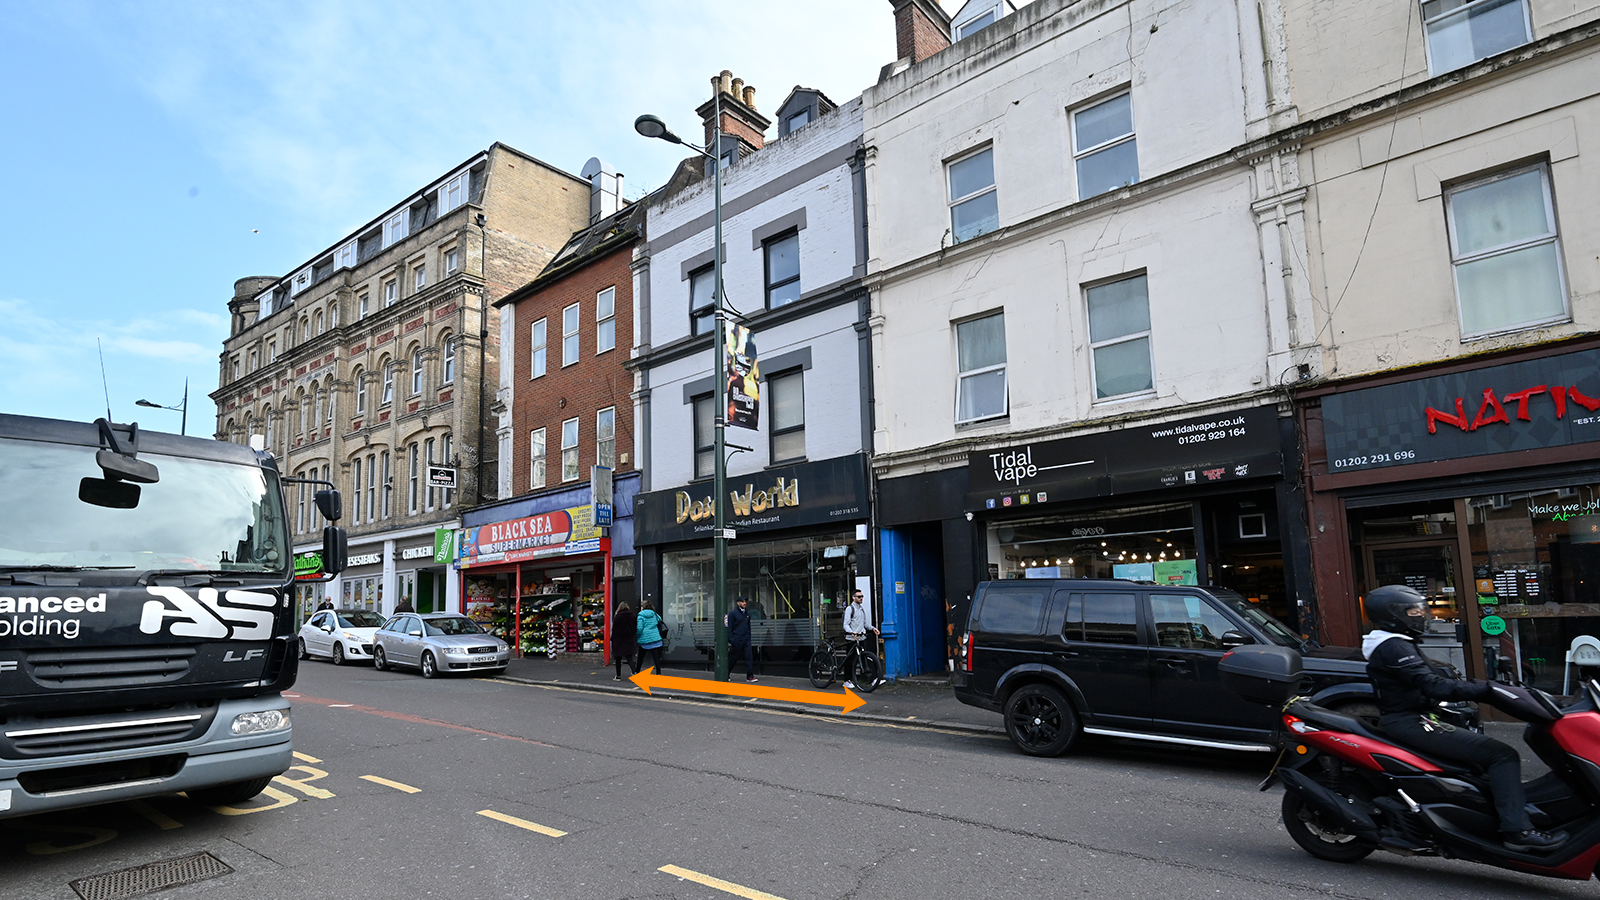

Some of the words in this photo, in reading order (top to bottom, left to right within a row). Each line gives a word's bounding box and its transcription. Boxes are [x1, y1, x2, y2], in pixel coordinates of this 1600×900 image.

[1151, 415, 1246, 439] www.tidalvape.co.uk
[1178, 433, 1206, 445] 01202
[1208, 430, 1226, 442] 929
[1228, 427, 1246, 438] 164
[989, 446, 1032, 469] Tidal
[1334, 456, 1368, 468] 01202
[1370, 453, 1391, 464] 291
[1393, 450, 1416, 461] 696
[993, 465, 1038, 486] vape
[730, 476, 800, 516] World
[1527, 503, 1561, 514] Make
[1561, 503, 1580, 512] we
[491, 519, 528, 542] BLACK
[529, 515, 553, 535] SEA
[751, 515, 780, 525] Restaurant
[491, 534, 553, 553] SUPERMARKET
[223, 649, 265, 663] LF
